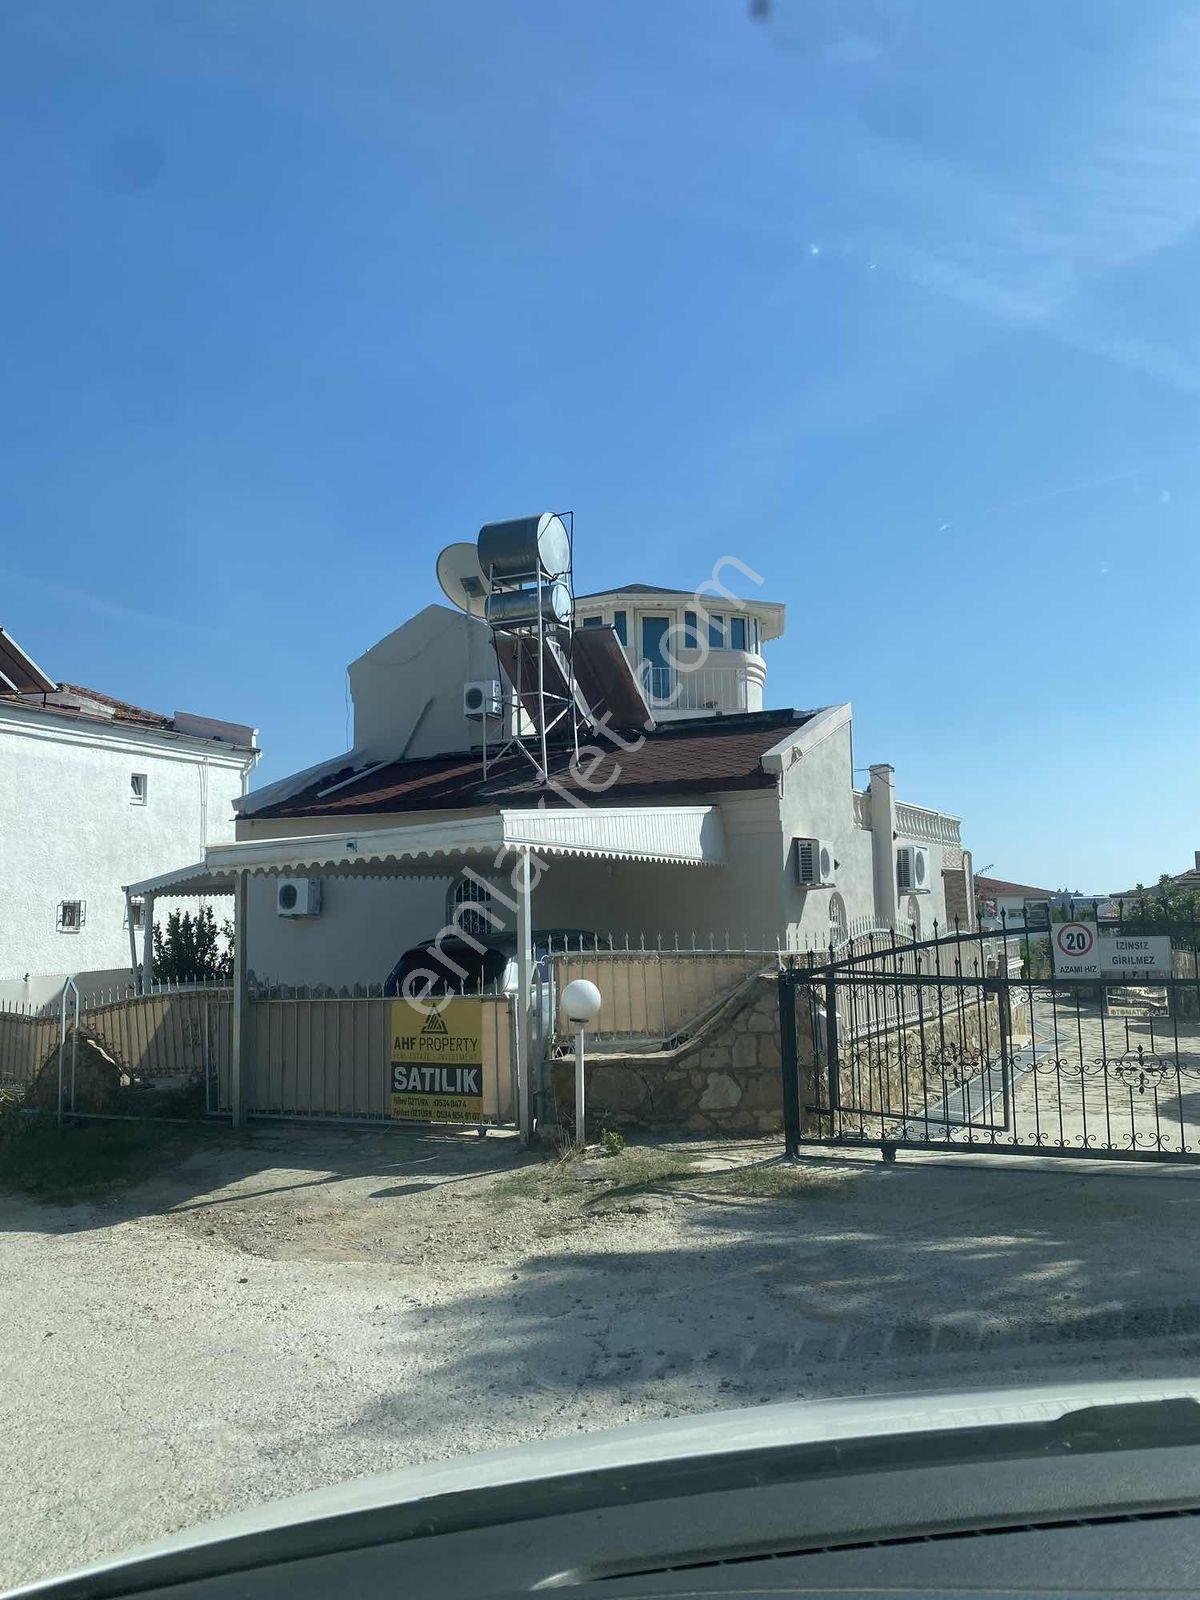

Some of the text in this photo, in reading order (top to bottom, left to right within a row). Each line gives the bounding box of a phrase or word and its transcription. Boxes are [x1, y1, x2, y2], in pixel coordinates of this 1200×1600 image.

[1066, 932, 1086, 951] 20
[1085, 965, 1097, 973] HIZ
[394, 1037, 478, 1052] AHF PROPERTY
[394, 1066, 479, 1093] SATILIK
